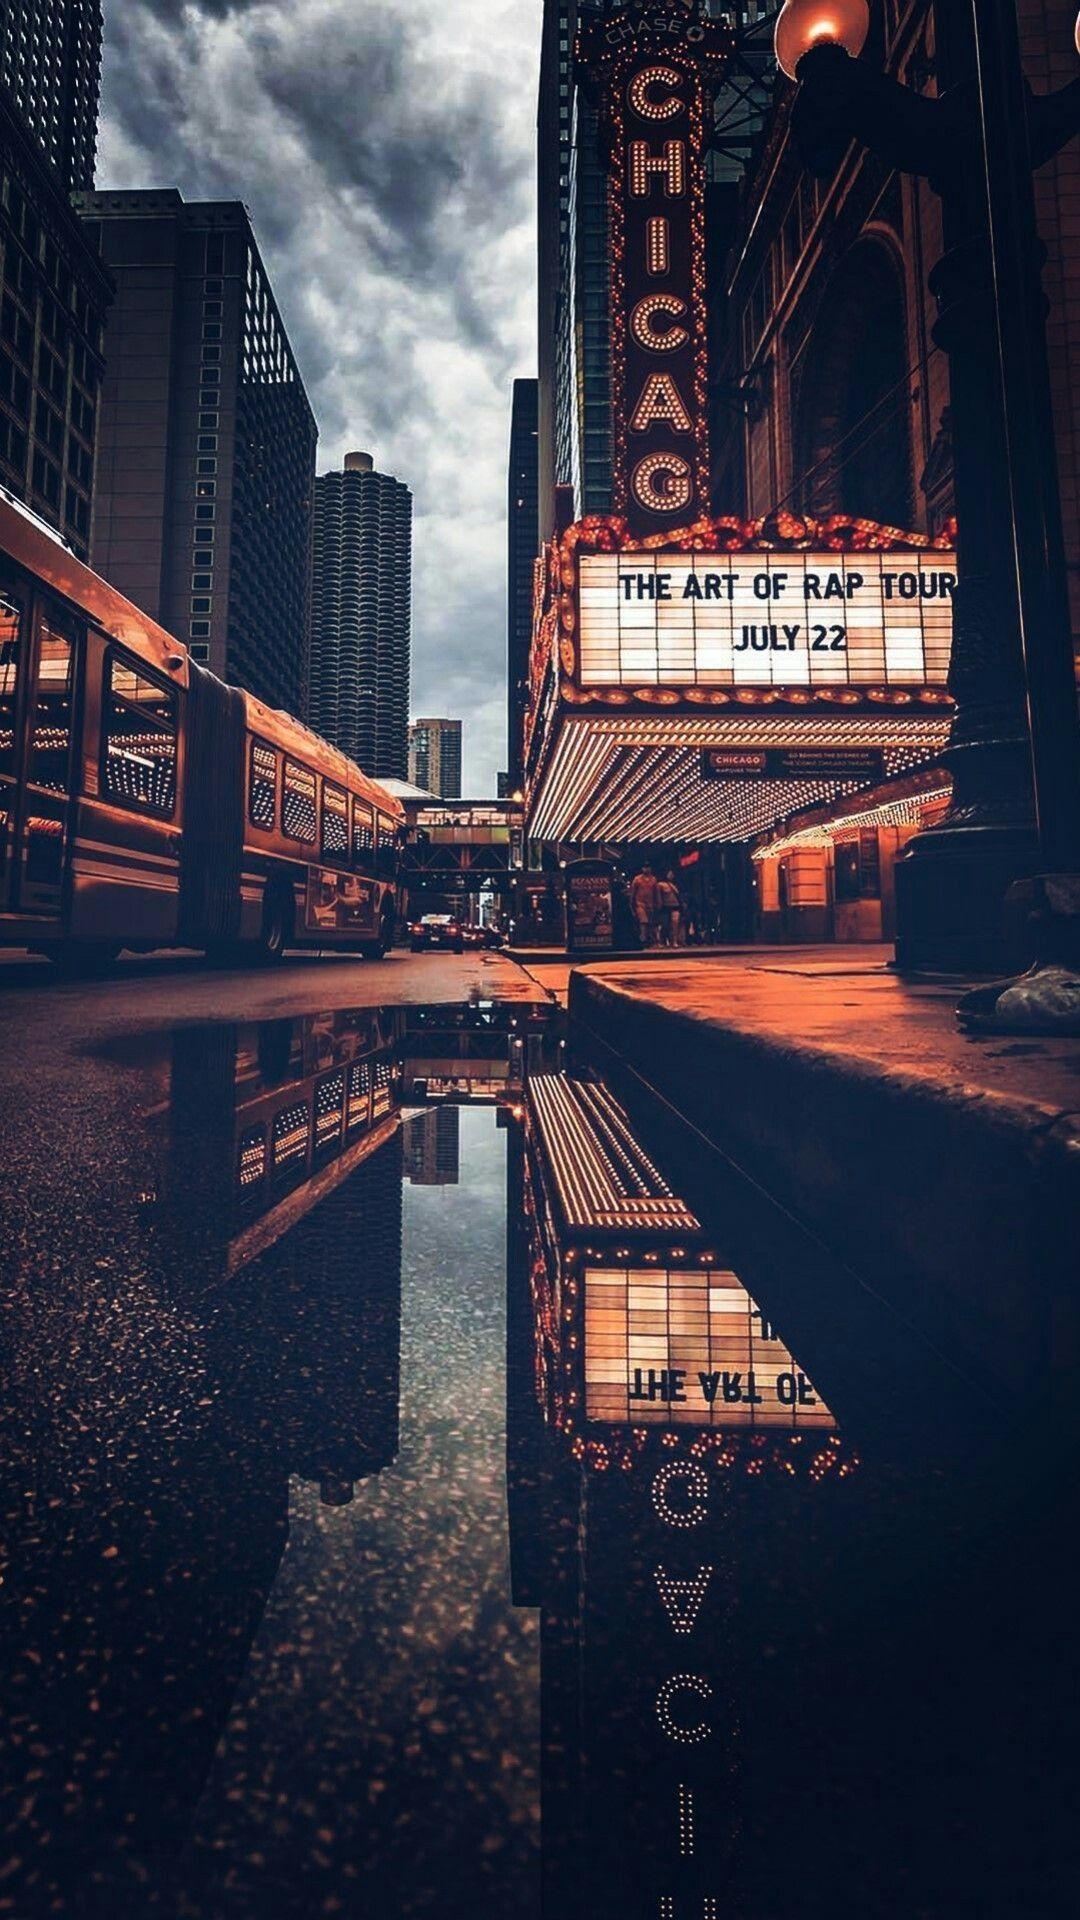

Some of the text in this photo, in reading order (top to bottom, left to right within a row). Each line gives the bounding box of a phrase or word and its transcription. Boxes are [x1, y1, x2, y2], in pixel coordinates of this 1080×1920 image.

[605, 18, 683, 44] CHASE
[619, 572, 957, 600] THE ART OF RAP TOUR
[733, 624, 848, 652] JULY 22
[715, 756, 761, 764] CHICAGO
